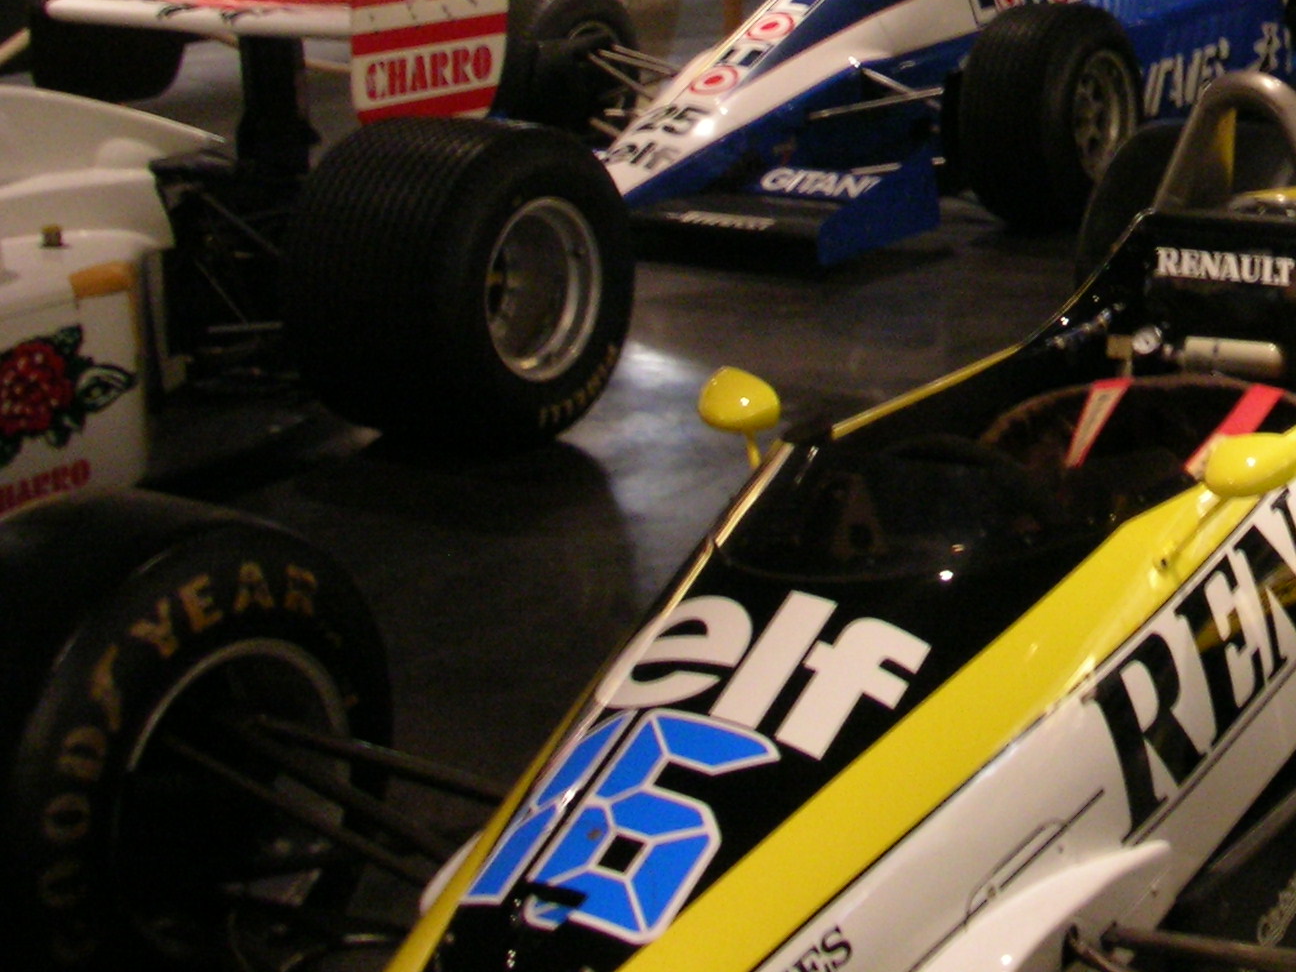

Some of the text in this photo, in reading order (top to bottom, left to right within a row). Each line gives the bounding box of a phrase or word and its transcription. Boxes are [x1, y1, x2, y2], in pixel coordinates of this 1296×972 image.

[365, 44, 493, 101] CHARRO
[1156, 245, 1296, 288] RENAULT
[0, 459, 91, 513] HARRO
[594, 589, 931, 761] elf
